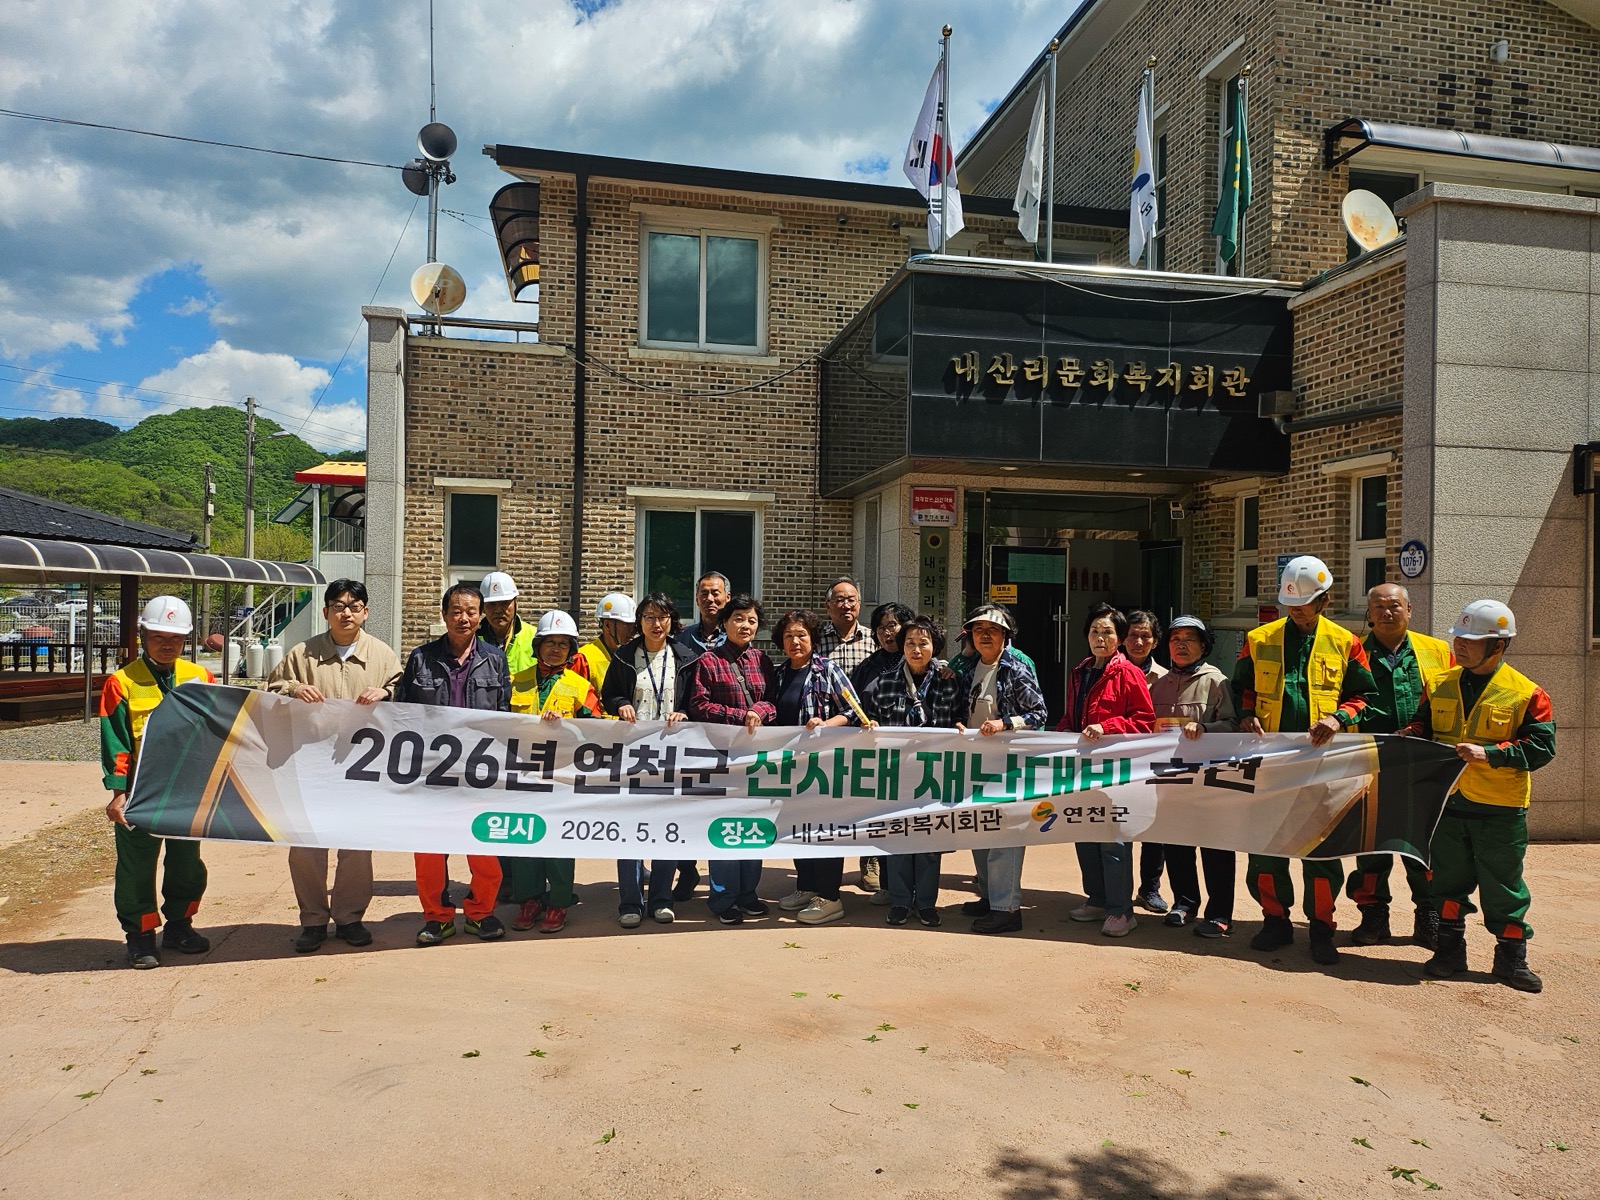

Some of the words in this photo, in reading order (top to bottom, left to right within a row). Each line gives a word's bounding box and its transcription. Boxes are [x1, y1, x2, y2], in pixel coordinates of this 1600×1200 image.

[1402, 556, 1423, 567] 1076-7
[345, 728, 557, 792] 2026년
[574, 743, 729, 796] 연천군
[745, 747, 901, 801] 산사태
[914, 750, 1132, 803] 재난대비
[486, 815, 534, 840] 일시
[561, 821, 627, 843] 2026.
[636, 822, 656, 843] 5.
[665, 823, 686, 843] 8.
[720, 821, 767, 846] 장소
[791, 822, 857, 844] 내산리
[866, 809, 1003, 839] 문화복지회관
[1063, 806, 1131, 824] 연천군
